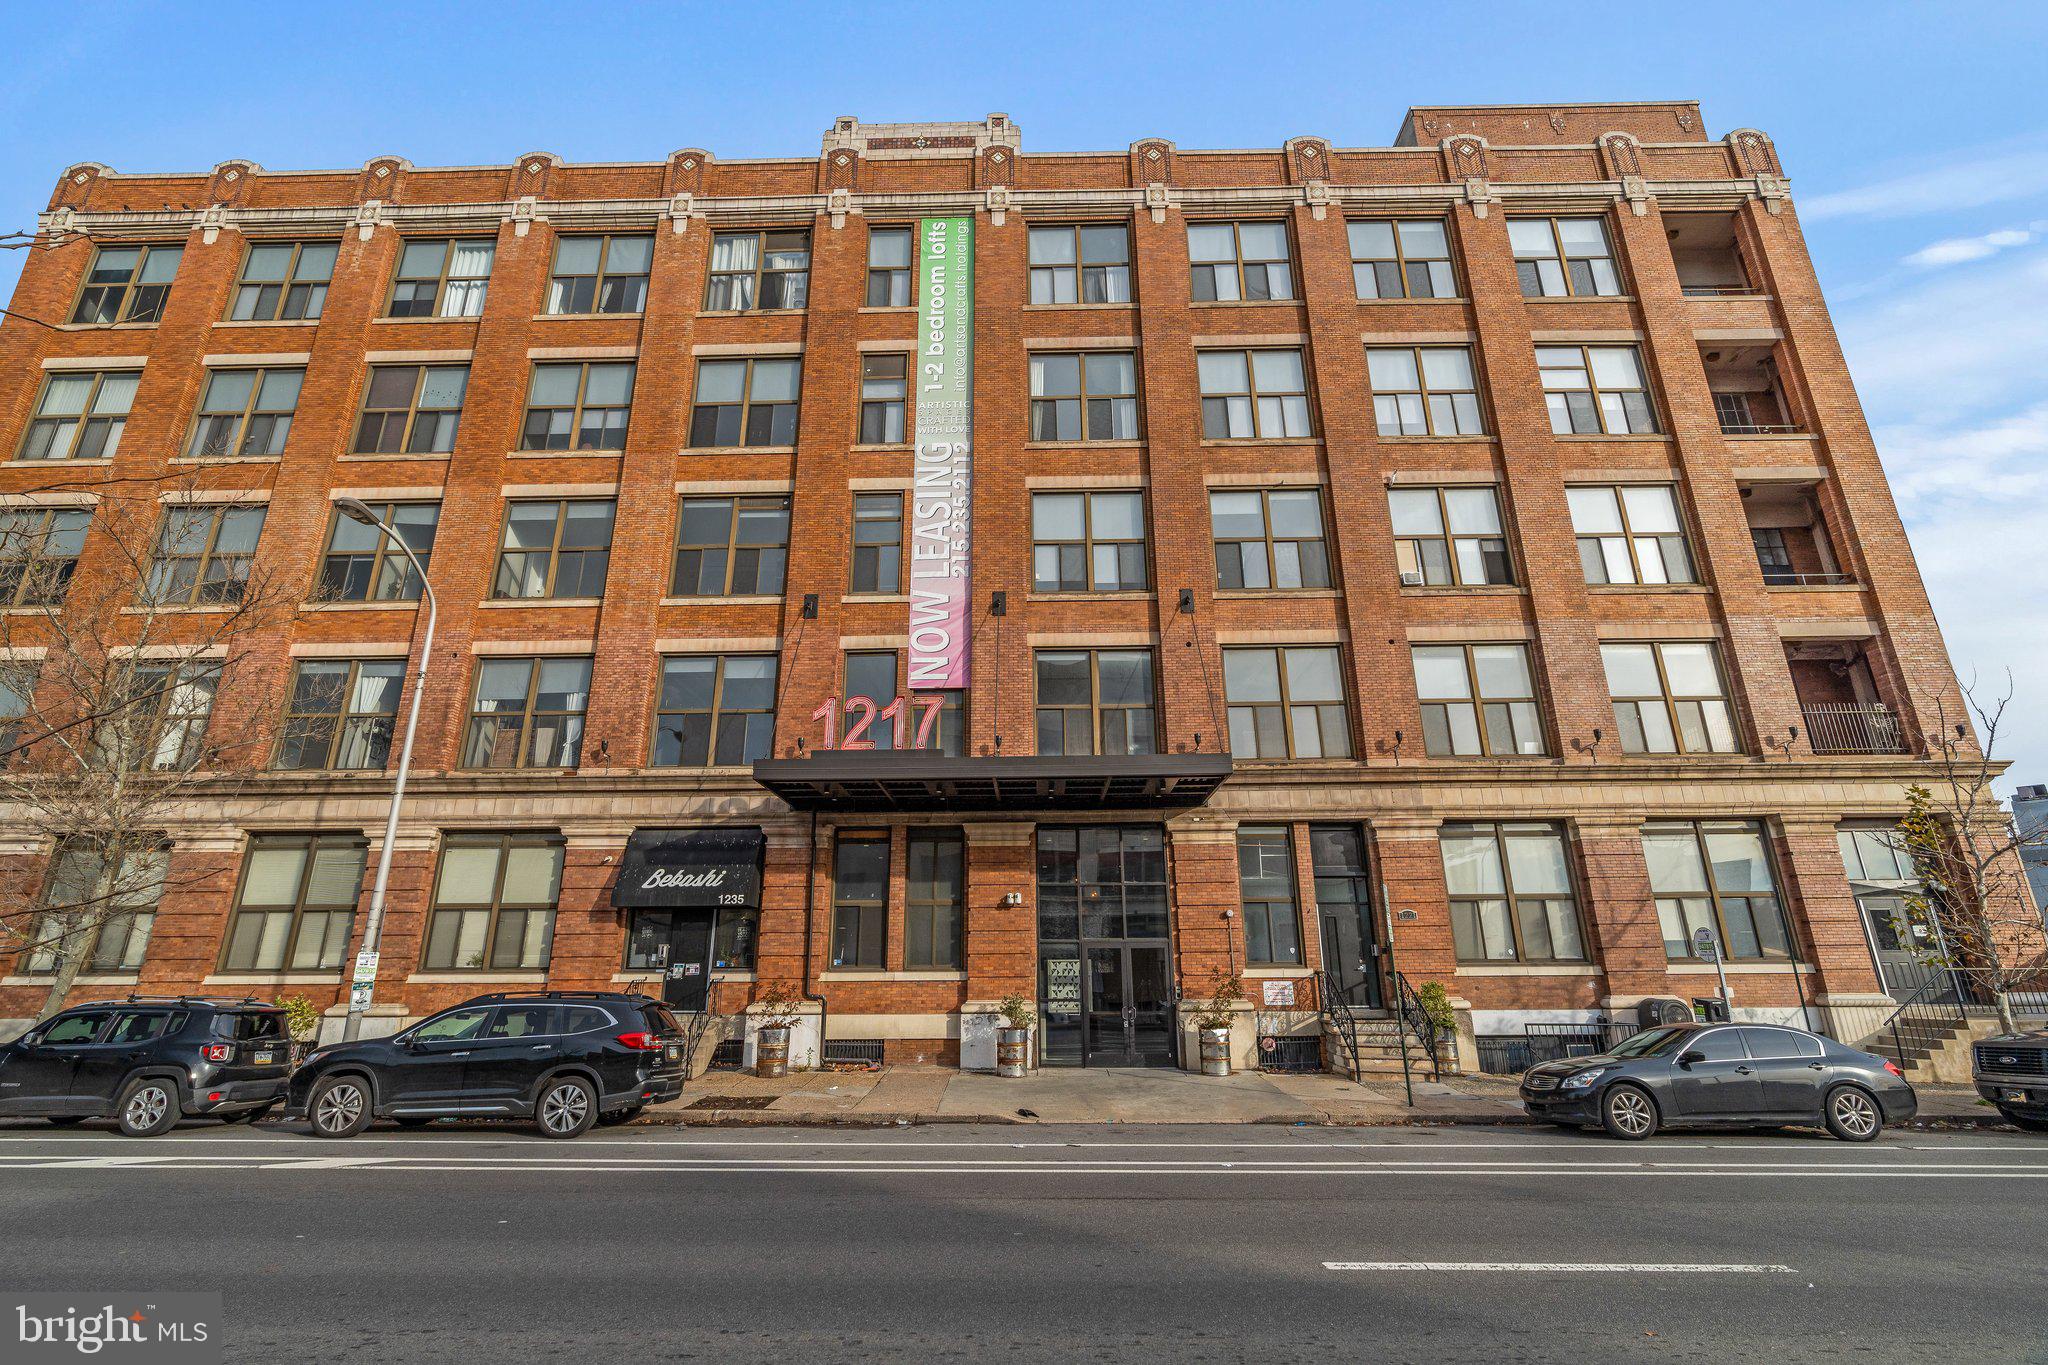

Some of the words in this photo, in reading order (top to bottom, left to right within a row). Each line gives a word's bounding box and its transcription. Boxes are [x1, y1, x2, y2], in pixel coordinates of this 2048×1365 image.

[927, 221, 947, 260] lofts
[926, 266, 946, 356] bedroom
[953, 221, 969, 392] info@artsandcrafts.holdings
[924, 363, 944, 393] 1-2
[918, 401, 970, 409] ARTISTIC
[918, 416, 971, 426] CRAFTED
[914, 442, 953, 578] LEASING
[951, 441, 972, 579] 215.235.2112
[910, 588, 951, 681] NOW
[812, 696, 945, 750] 1217
[641, 868, 727, 889] Bebashi
[718, 894, 745, 905] 1235
